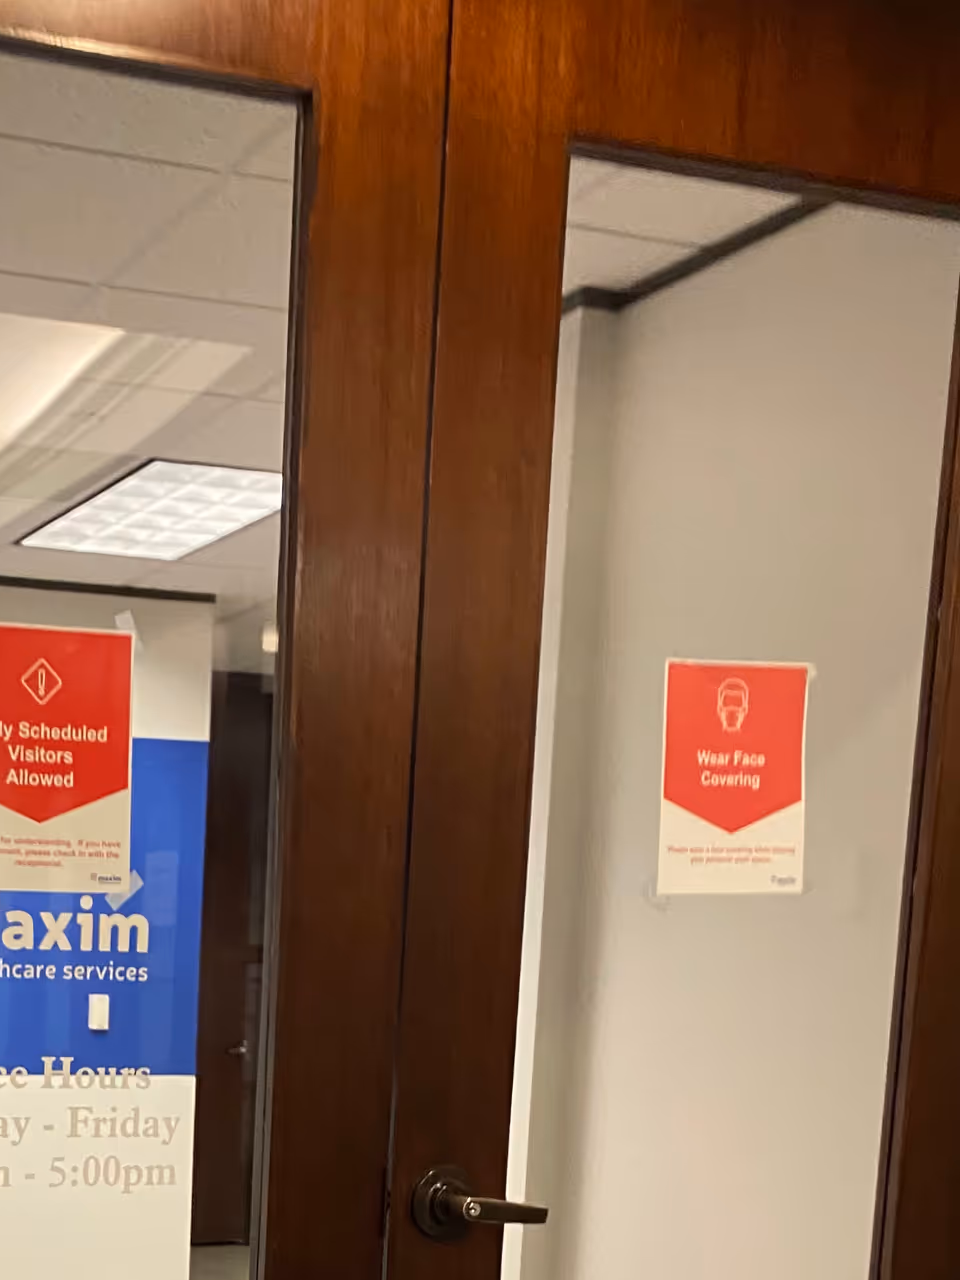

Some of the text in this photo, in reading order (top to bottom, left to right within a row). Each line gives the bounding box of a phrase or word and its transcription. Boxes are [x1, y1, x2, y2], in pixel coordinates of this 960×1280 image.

[18, 721, 108, 743] Scheduled
[7, 744, 73, 764] Visitors
[697, 749, 766, 768] Wear Face
[5, 768, 74, 788] Allowed
[701, 770, 761, 791] Covering
[62, 960, 148, 982] services
[40, 1056, 152, 1090] Hours
[66, 1106, 181, 1145] Friday
[48, 1155, 177, 1194] 5:00pm
